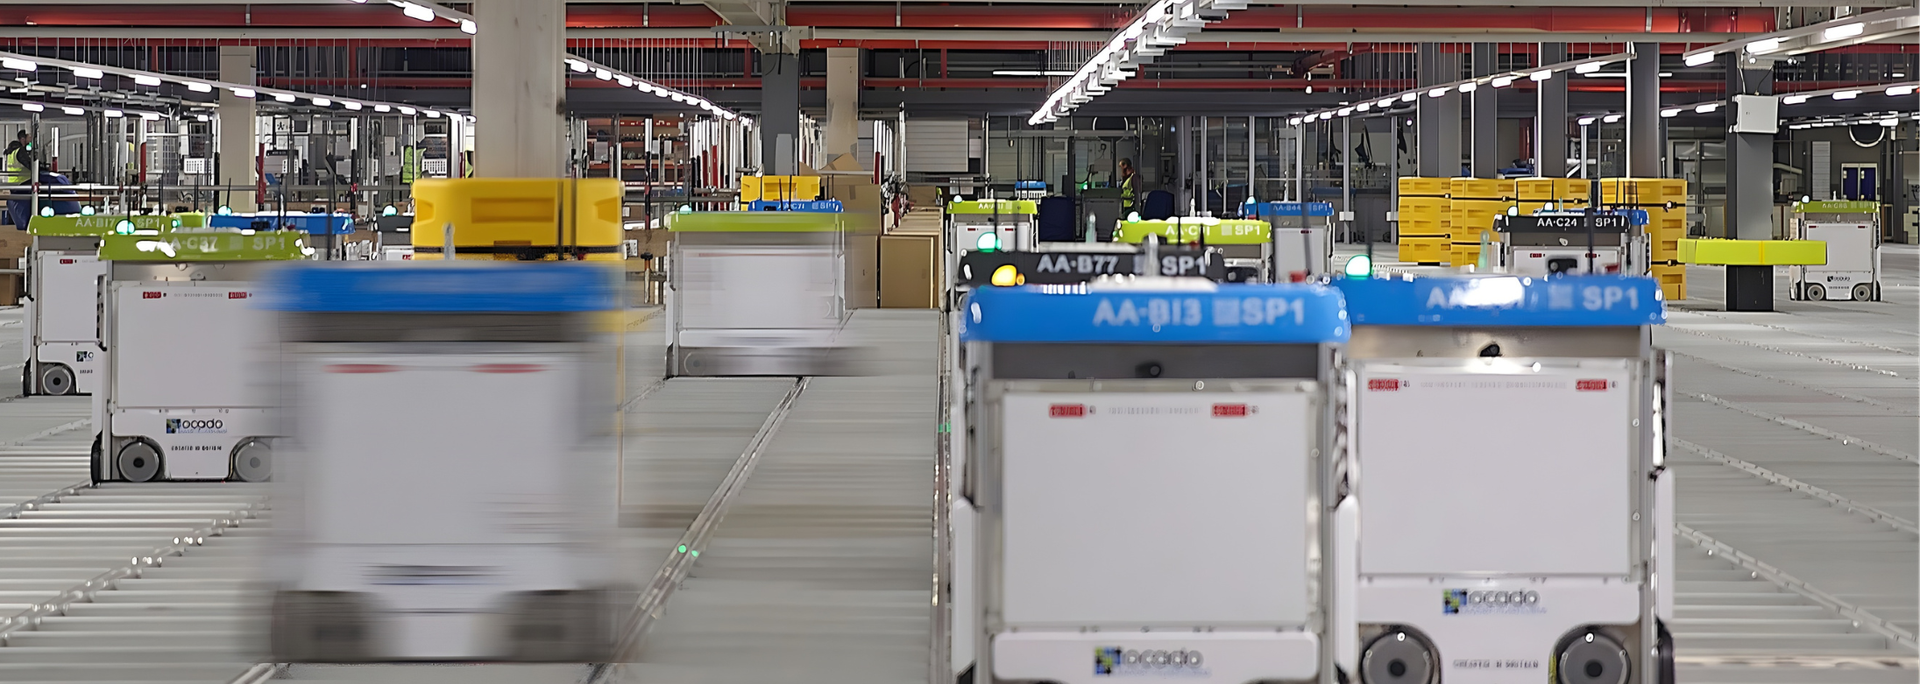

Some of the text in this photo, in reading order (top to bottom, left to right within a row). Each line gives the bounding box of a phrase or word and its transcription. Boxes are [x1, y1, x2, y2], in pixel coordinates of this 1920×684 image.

[1312, 204, 1328, 212] SP1
[136, 218, 160, 228] SP1
[1595, 217, 1617, 227] SP1
[1234, 225, 1261, 236] SP1
[252, 236, 286, 250] SP1
[1161, 255, 1206, 275] SP1
[1582, 285, 1640, 311] SP1
[1241, 297, 1306, 327] SP1
